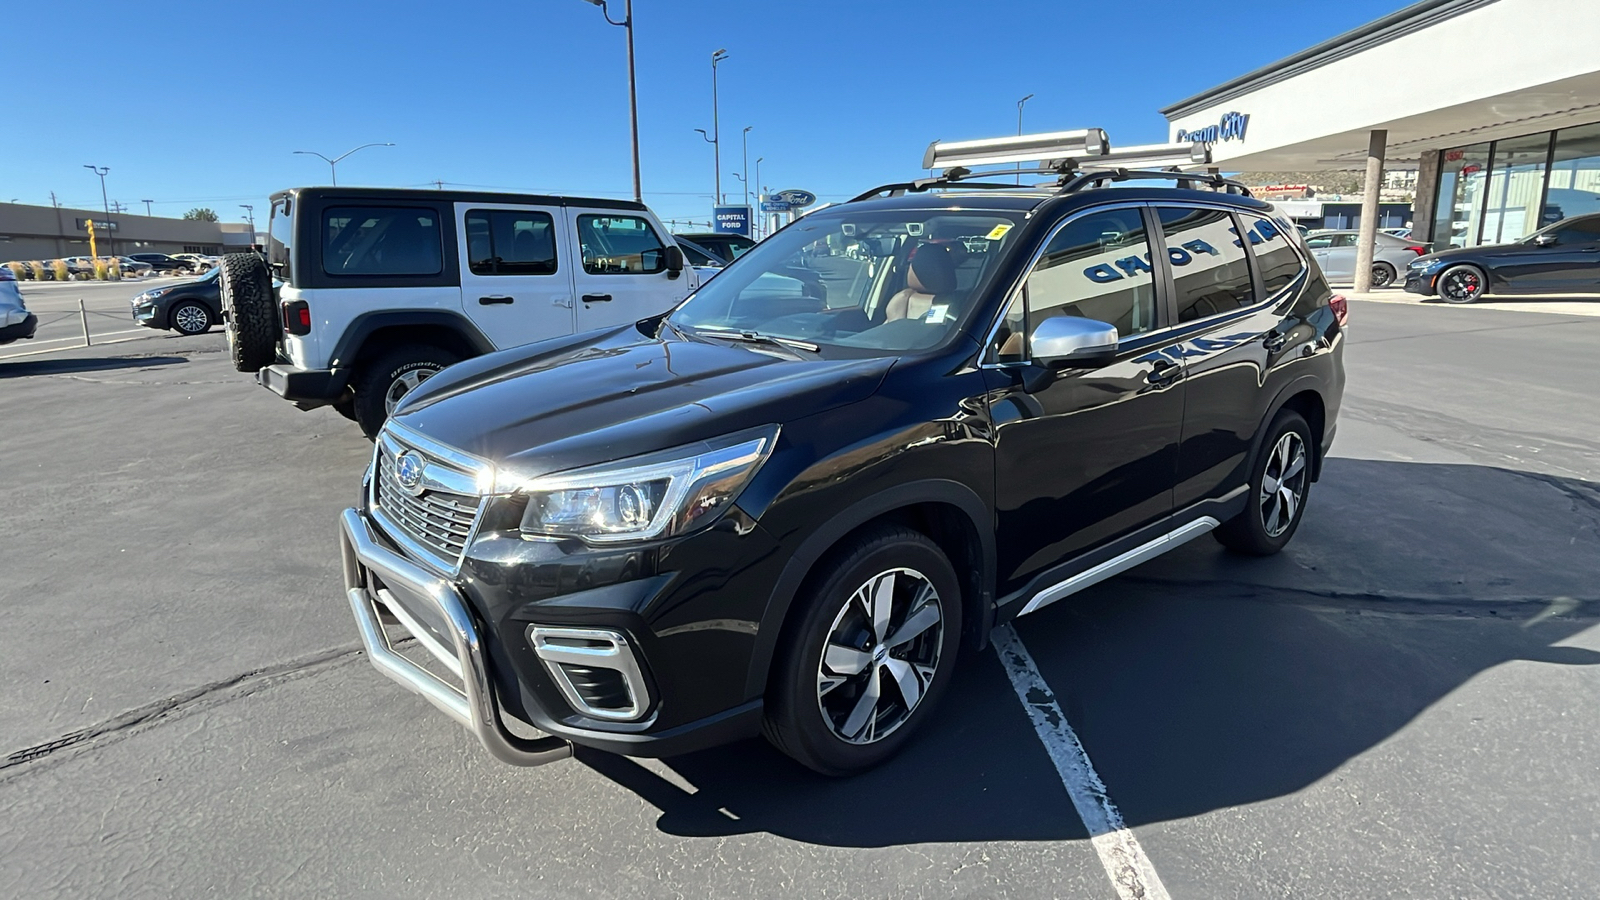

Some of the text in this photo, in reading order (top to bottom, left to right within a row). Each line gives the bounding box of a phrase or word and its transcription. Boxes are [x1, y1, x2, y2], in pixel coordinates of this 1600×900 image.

[1177, 111, 1250, 144] Carson City
[781, 193, 808, 204] Ford
[390, 361, 445, 378] BFGoodric
